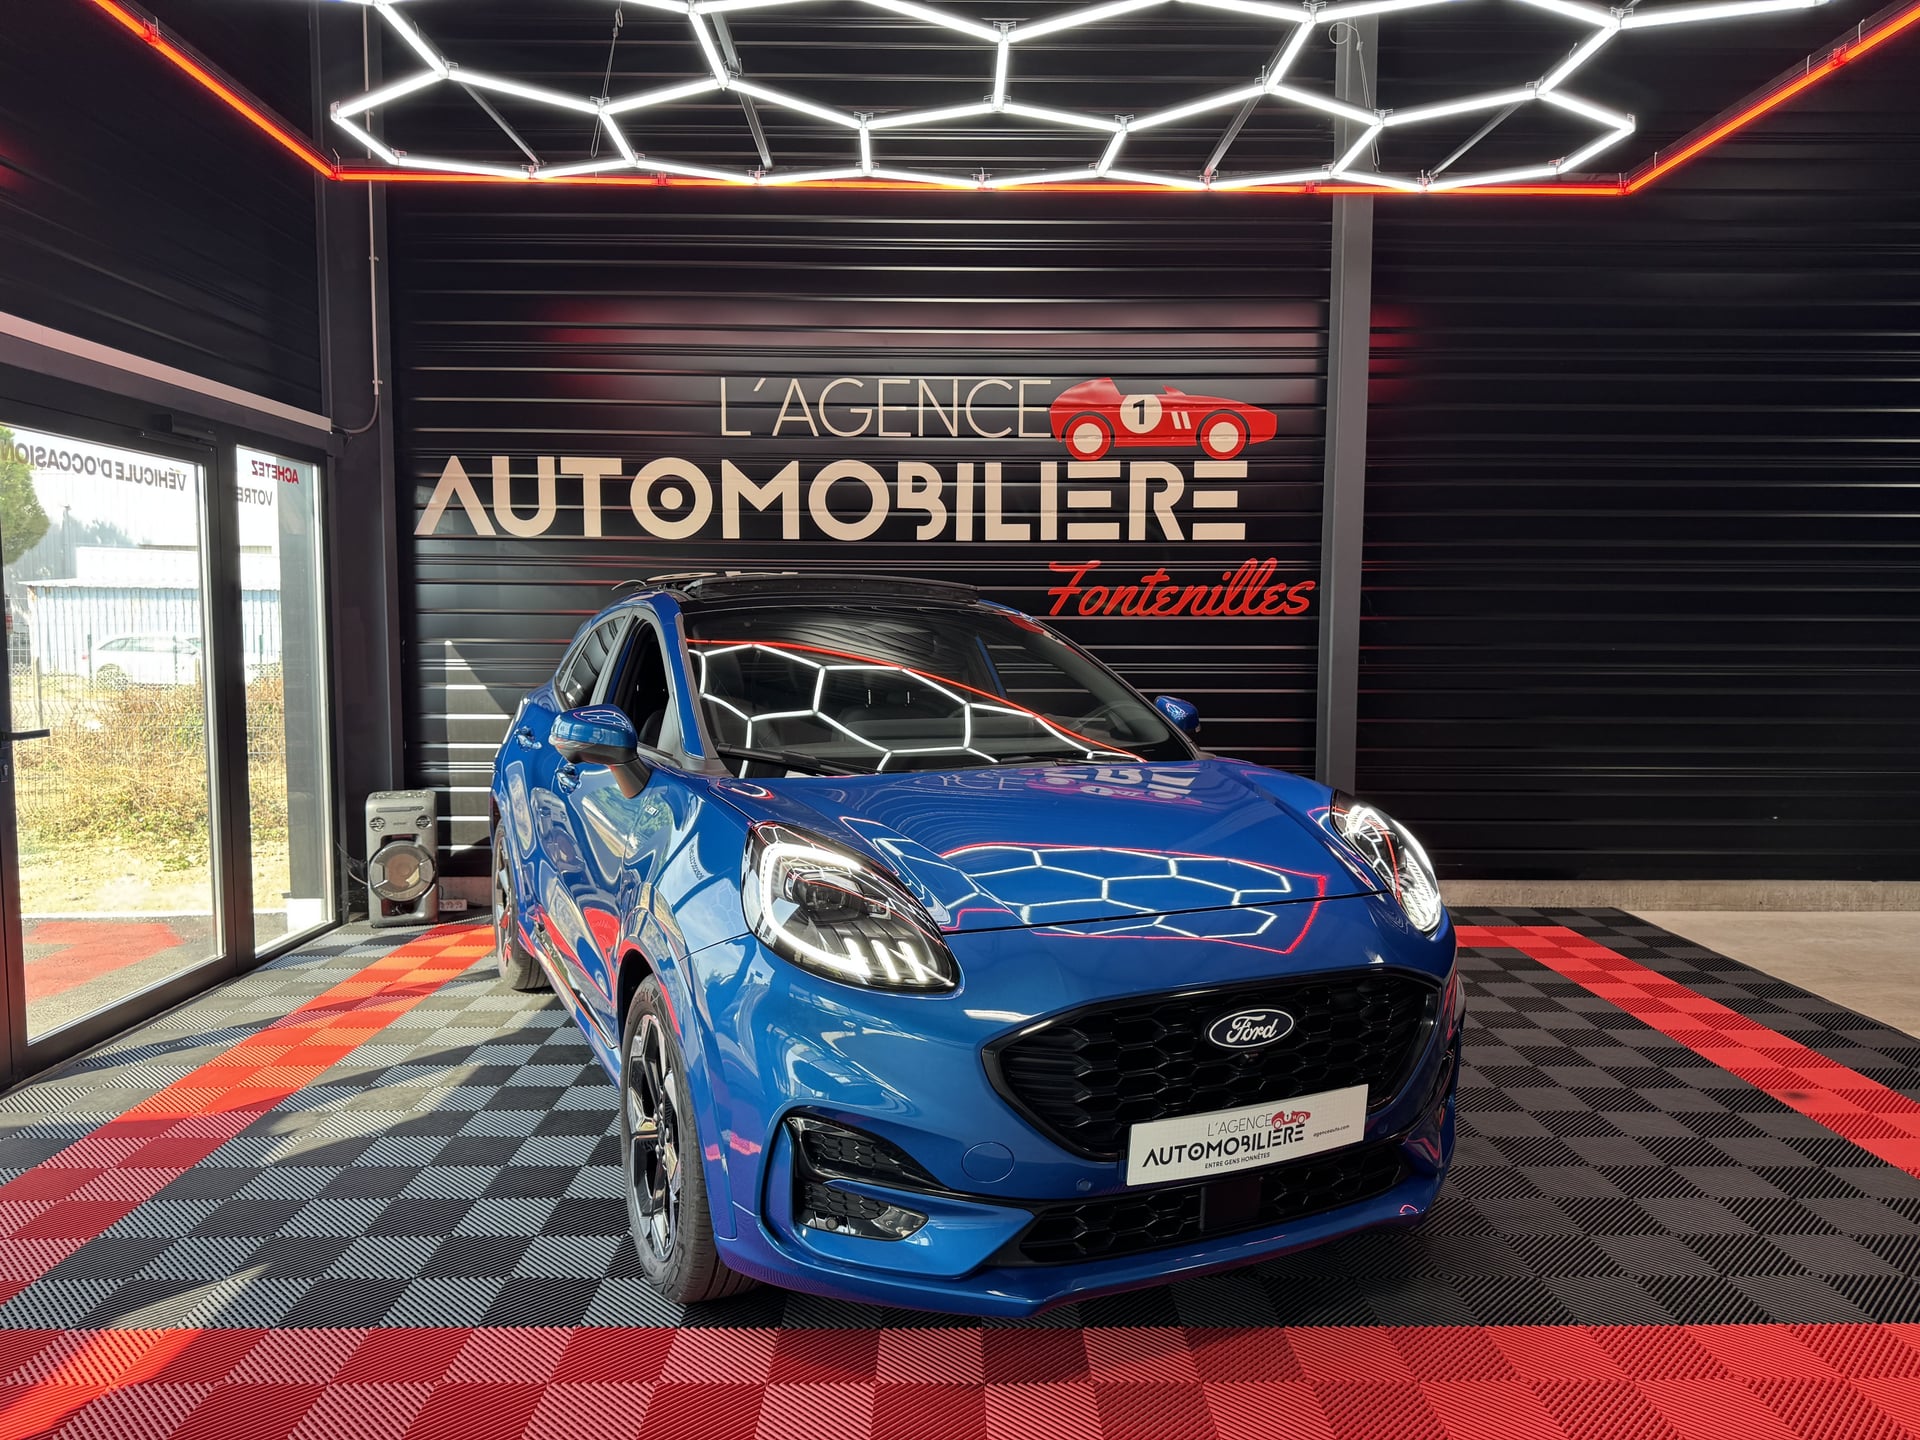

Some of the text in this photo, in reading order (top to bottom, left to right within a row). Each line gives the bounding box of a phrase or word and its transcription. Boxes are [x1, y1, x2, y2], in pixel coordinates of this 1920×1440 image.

[720, 376, 1052, 437] L'AGENCE
[1132, 399, 1147, 425] 1
[1048, 557, 1316, 616] Fontenilles
[1226, 1014, 1279, 1043] Ford
[1207, 1113, 1274, 1137] L'AGENCE
[1205, 1160, 1223, 1169] ENTRE
[1224, 1157, 1240, 1166] GENS
